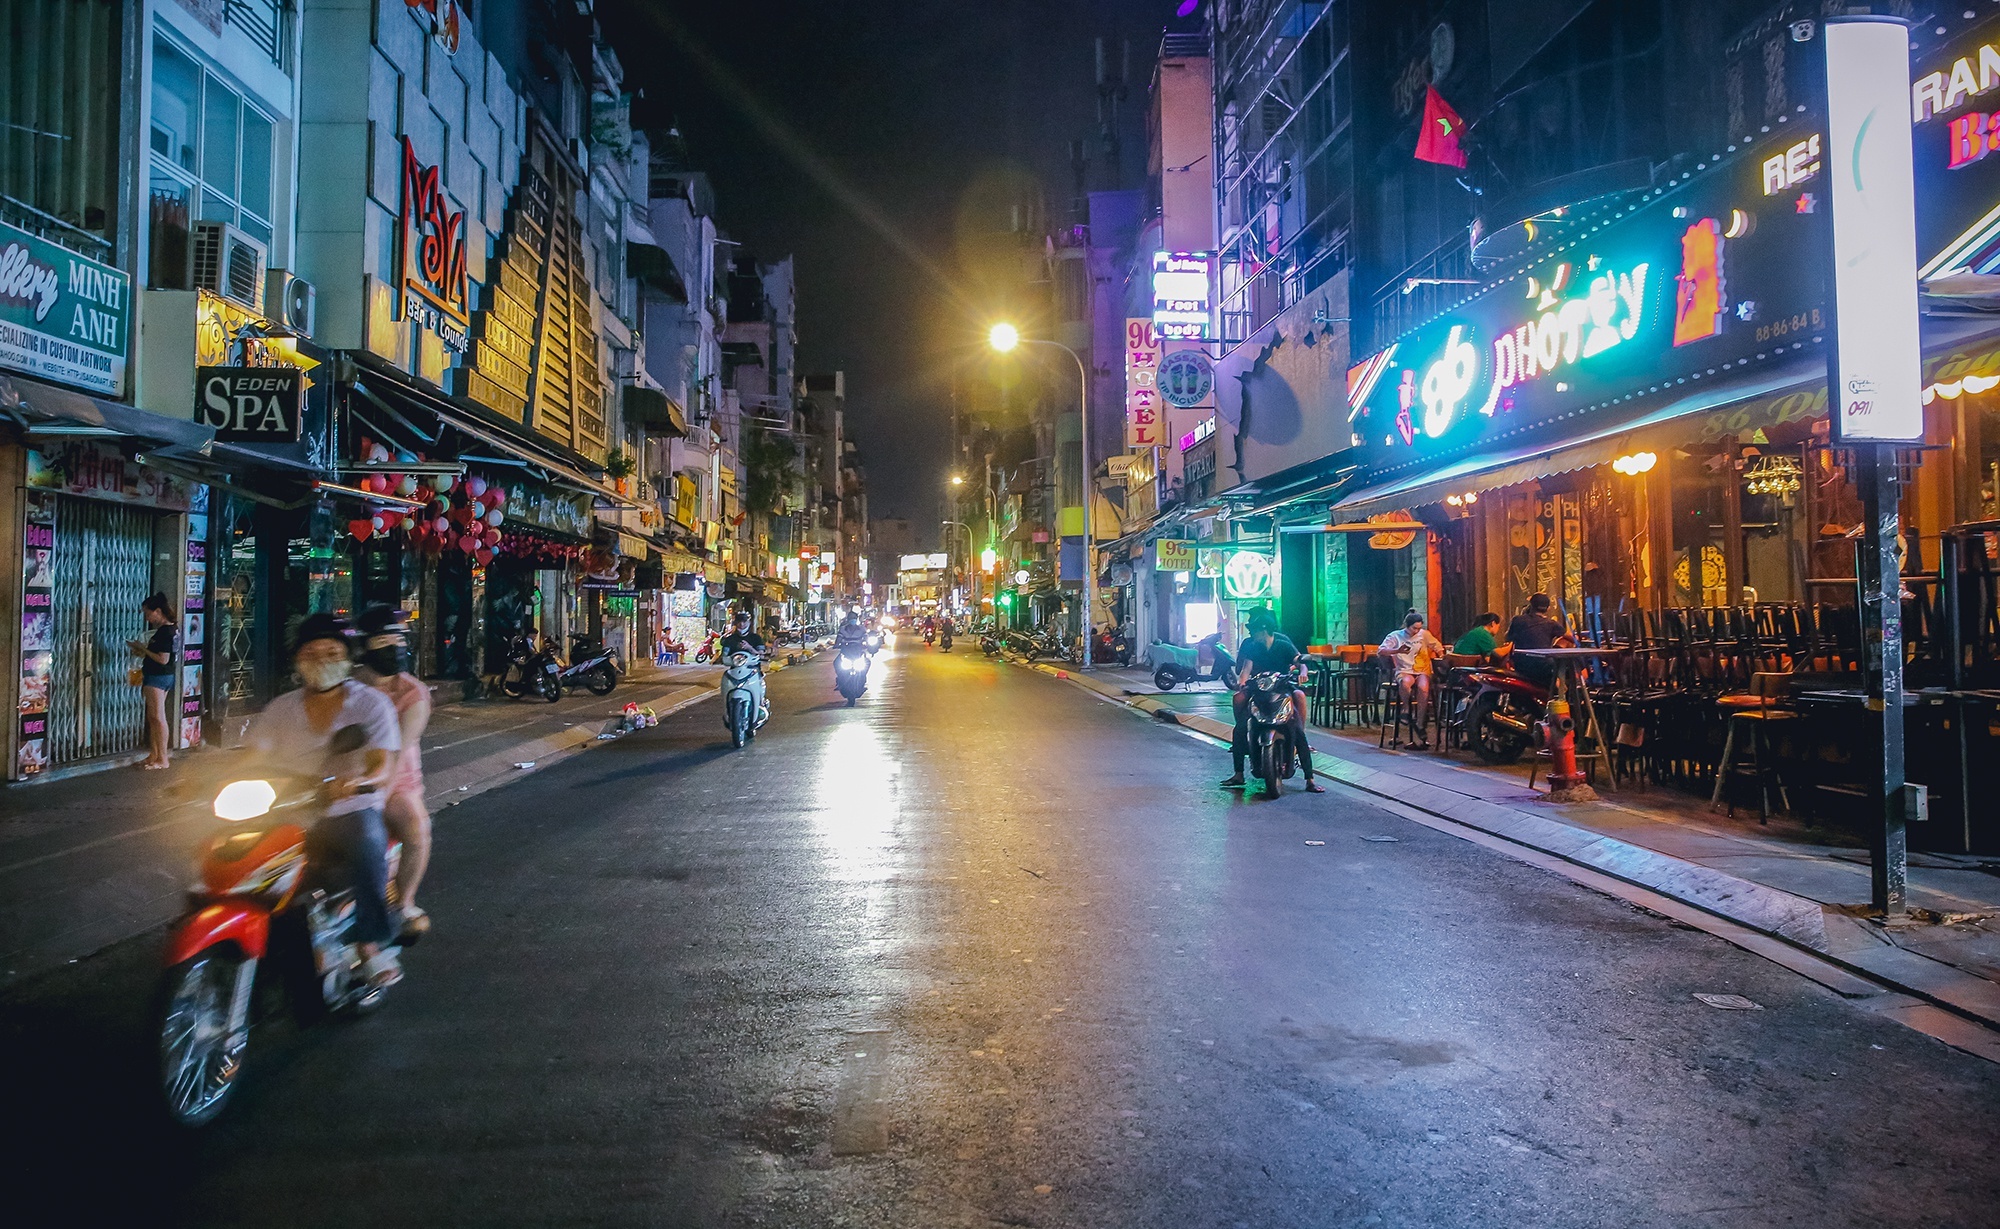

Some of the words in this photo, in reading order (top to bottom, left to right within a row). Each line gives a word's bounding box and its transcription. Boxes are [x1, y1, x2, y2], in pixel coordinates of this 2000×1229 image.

[0, 243, 58, 322] llery
[68, 259, 121, 310] MINH
[1166, 300, 1199, 311] Foot
[70, 303, 118, 349] ANH
[1164, 323, 1202, 335] body
[40, 337, 47, 355] IN
[50, 341, 78, 364] CUSTOM
[80, 351, 112, 373] ARTWORK
[1160, 355, 1208, 375] MASSAGE
[235, 378, 292, 391] EDEN
[1160, 381, 1170, 393] TIP
[1169, 381, 1209, 405] INCLUDED
[1421, 325, 1476, 438] 86
[203, 377, 289, 432] SPA
[1133, 352, 1155, 444] HOTEL
[27, 524, 53, 547] Eden
[1166, 541, 1188, 557] 96
